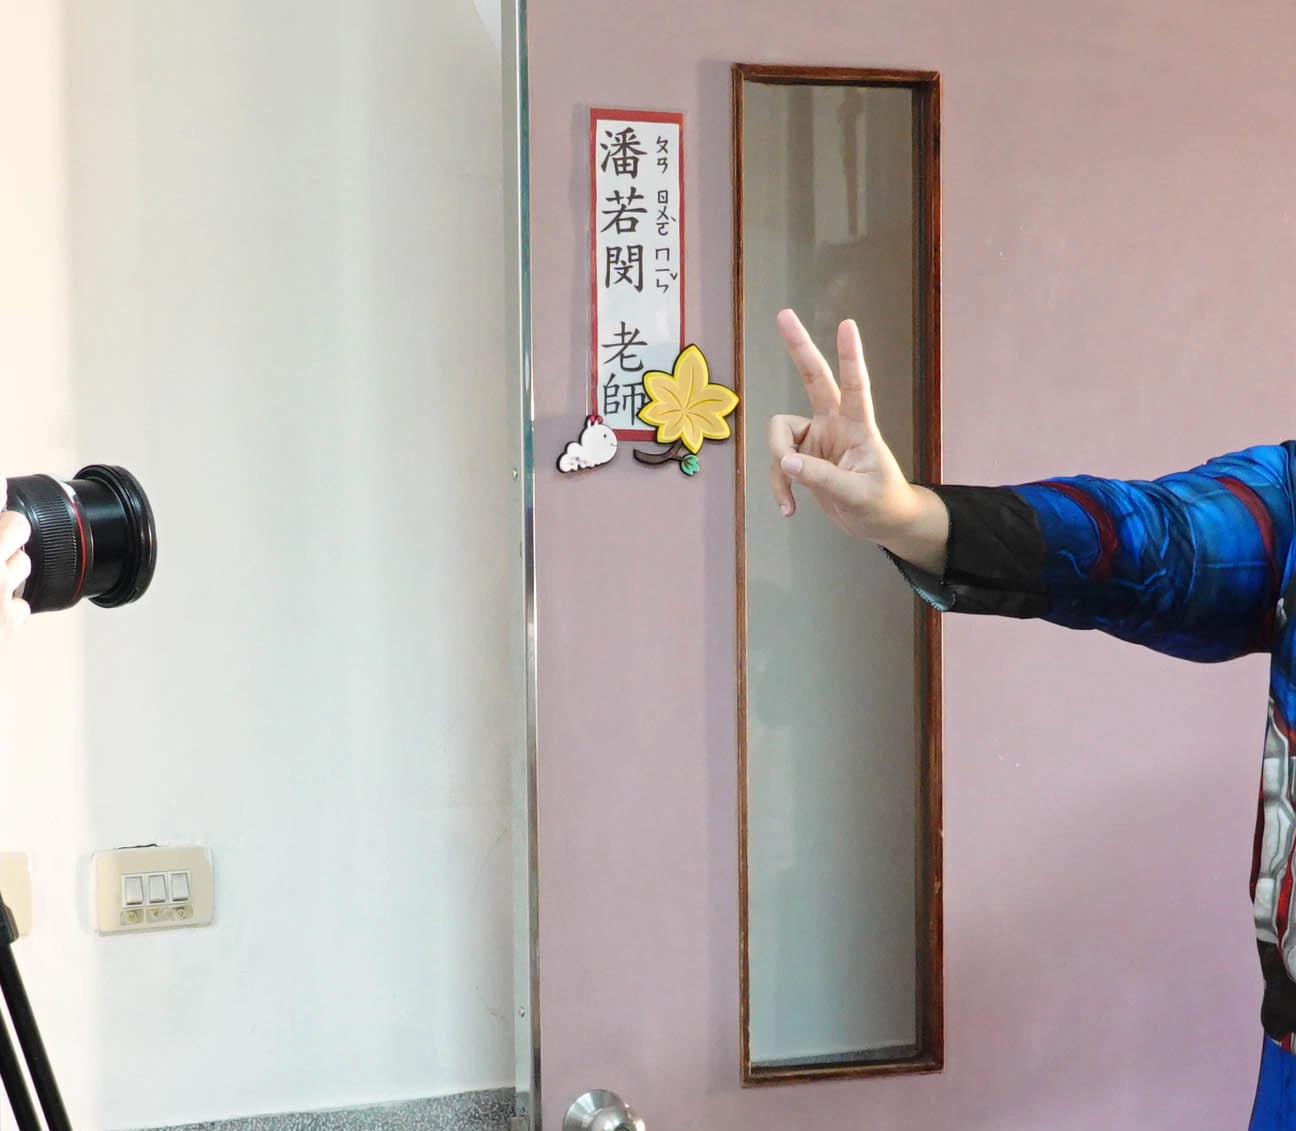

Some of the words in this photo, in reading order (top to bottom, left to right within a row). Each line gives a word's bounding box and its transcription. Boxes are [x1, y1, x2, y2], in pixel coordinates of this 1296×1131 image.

[600, 127, 648, 293] 潘若閔
[602, 321, 648, 426] 老師
